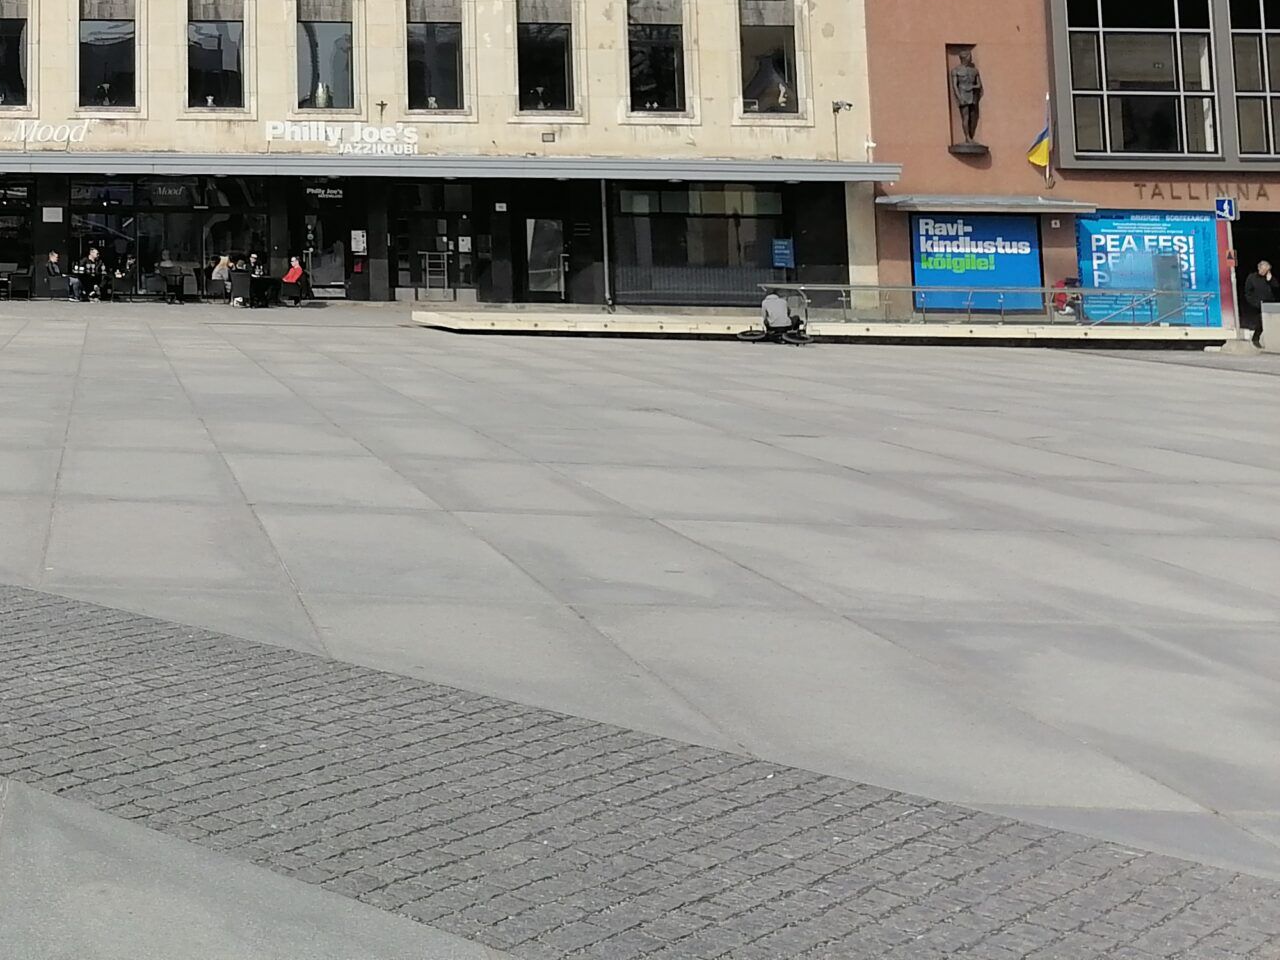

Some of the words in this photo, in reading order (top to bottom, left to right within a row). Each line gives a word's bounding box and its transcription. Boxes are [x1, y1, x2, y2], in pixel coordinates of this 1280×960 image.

[265, 121, 343, 147] Philly
[351, 121, 419, 143] Joe's
[337, 143, 419, 155] JAZZIKLUBI
[1133, 182, 1270, 201] TALLINNA
[919, 218, 973, 236] Ravi-
[920, 236, 1031, 254] kindlustus
[1091, 234, 1138, 252] PEA
